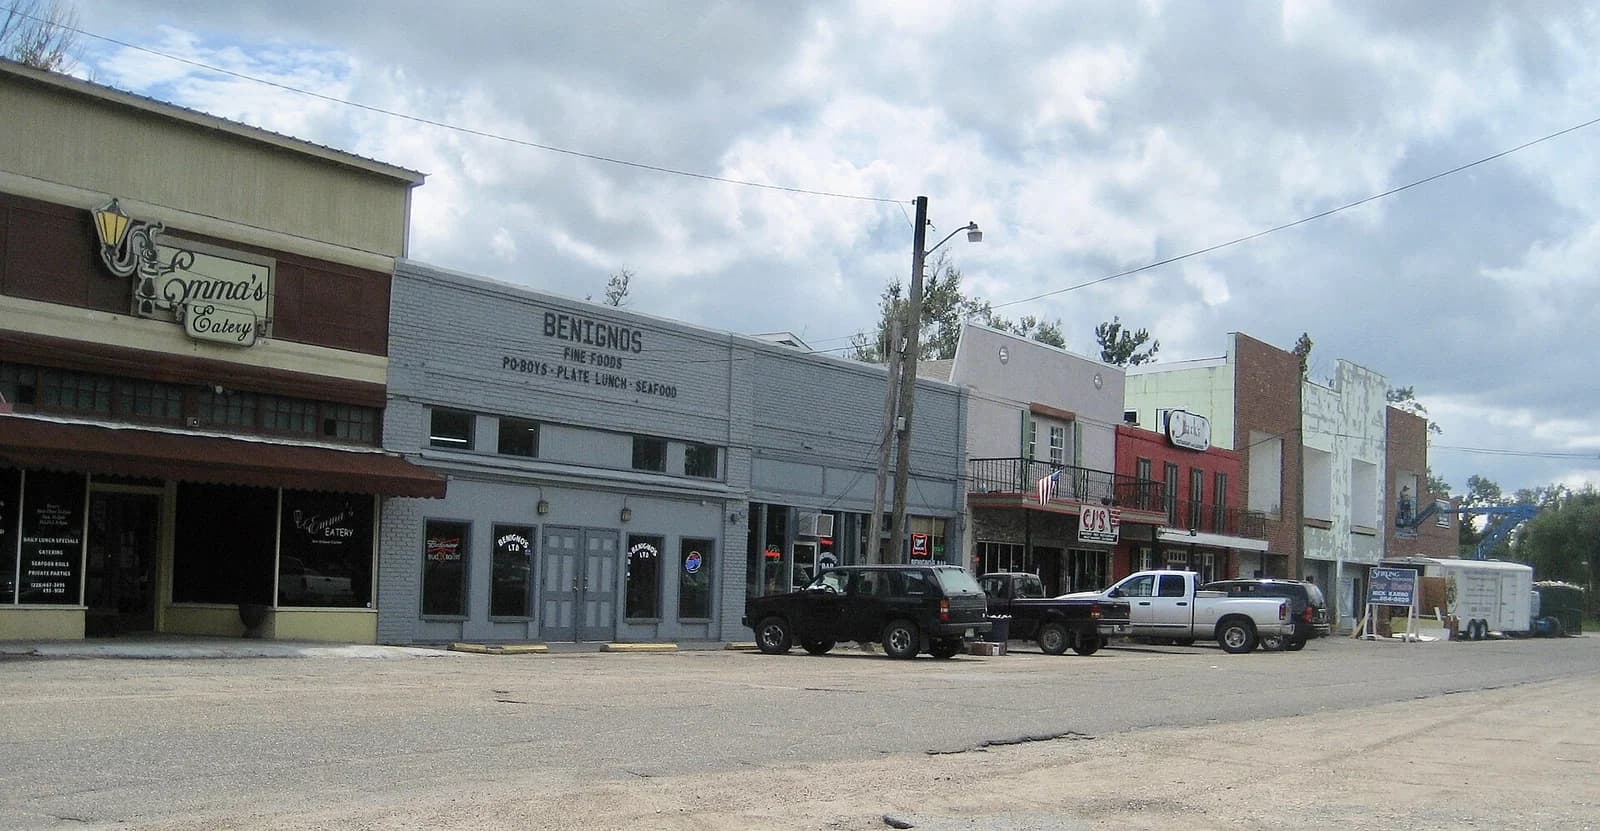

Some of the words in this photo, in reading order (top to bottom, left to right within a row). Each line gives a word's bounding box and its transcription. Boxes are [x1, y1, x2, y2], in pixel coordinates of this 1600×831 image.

[159, 249, 267, 307] Emma's
[193, 305, 252, 341] Eatery
[543, 312, 643, 354] BENIGNOS
[563, 347, 587, 364] FINE
[590, 352, 623, 370] FOODS
[556, 365, 590, 384] PLATE
[595, 373, 627, 390] LUNCH
[635, 380, 678, 398] SEAFOOD
[324, 527, 354, 537] EATERY
[1082, 508, 1106, 531] CJ'S
[508, 543, 520, 552] LTD
